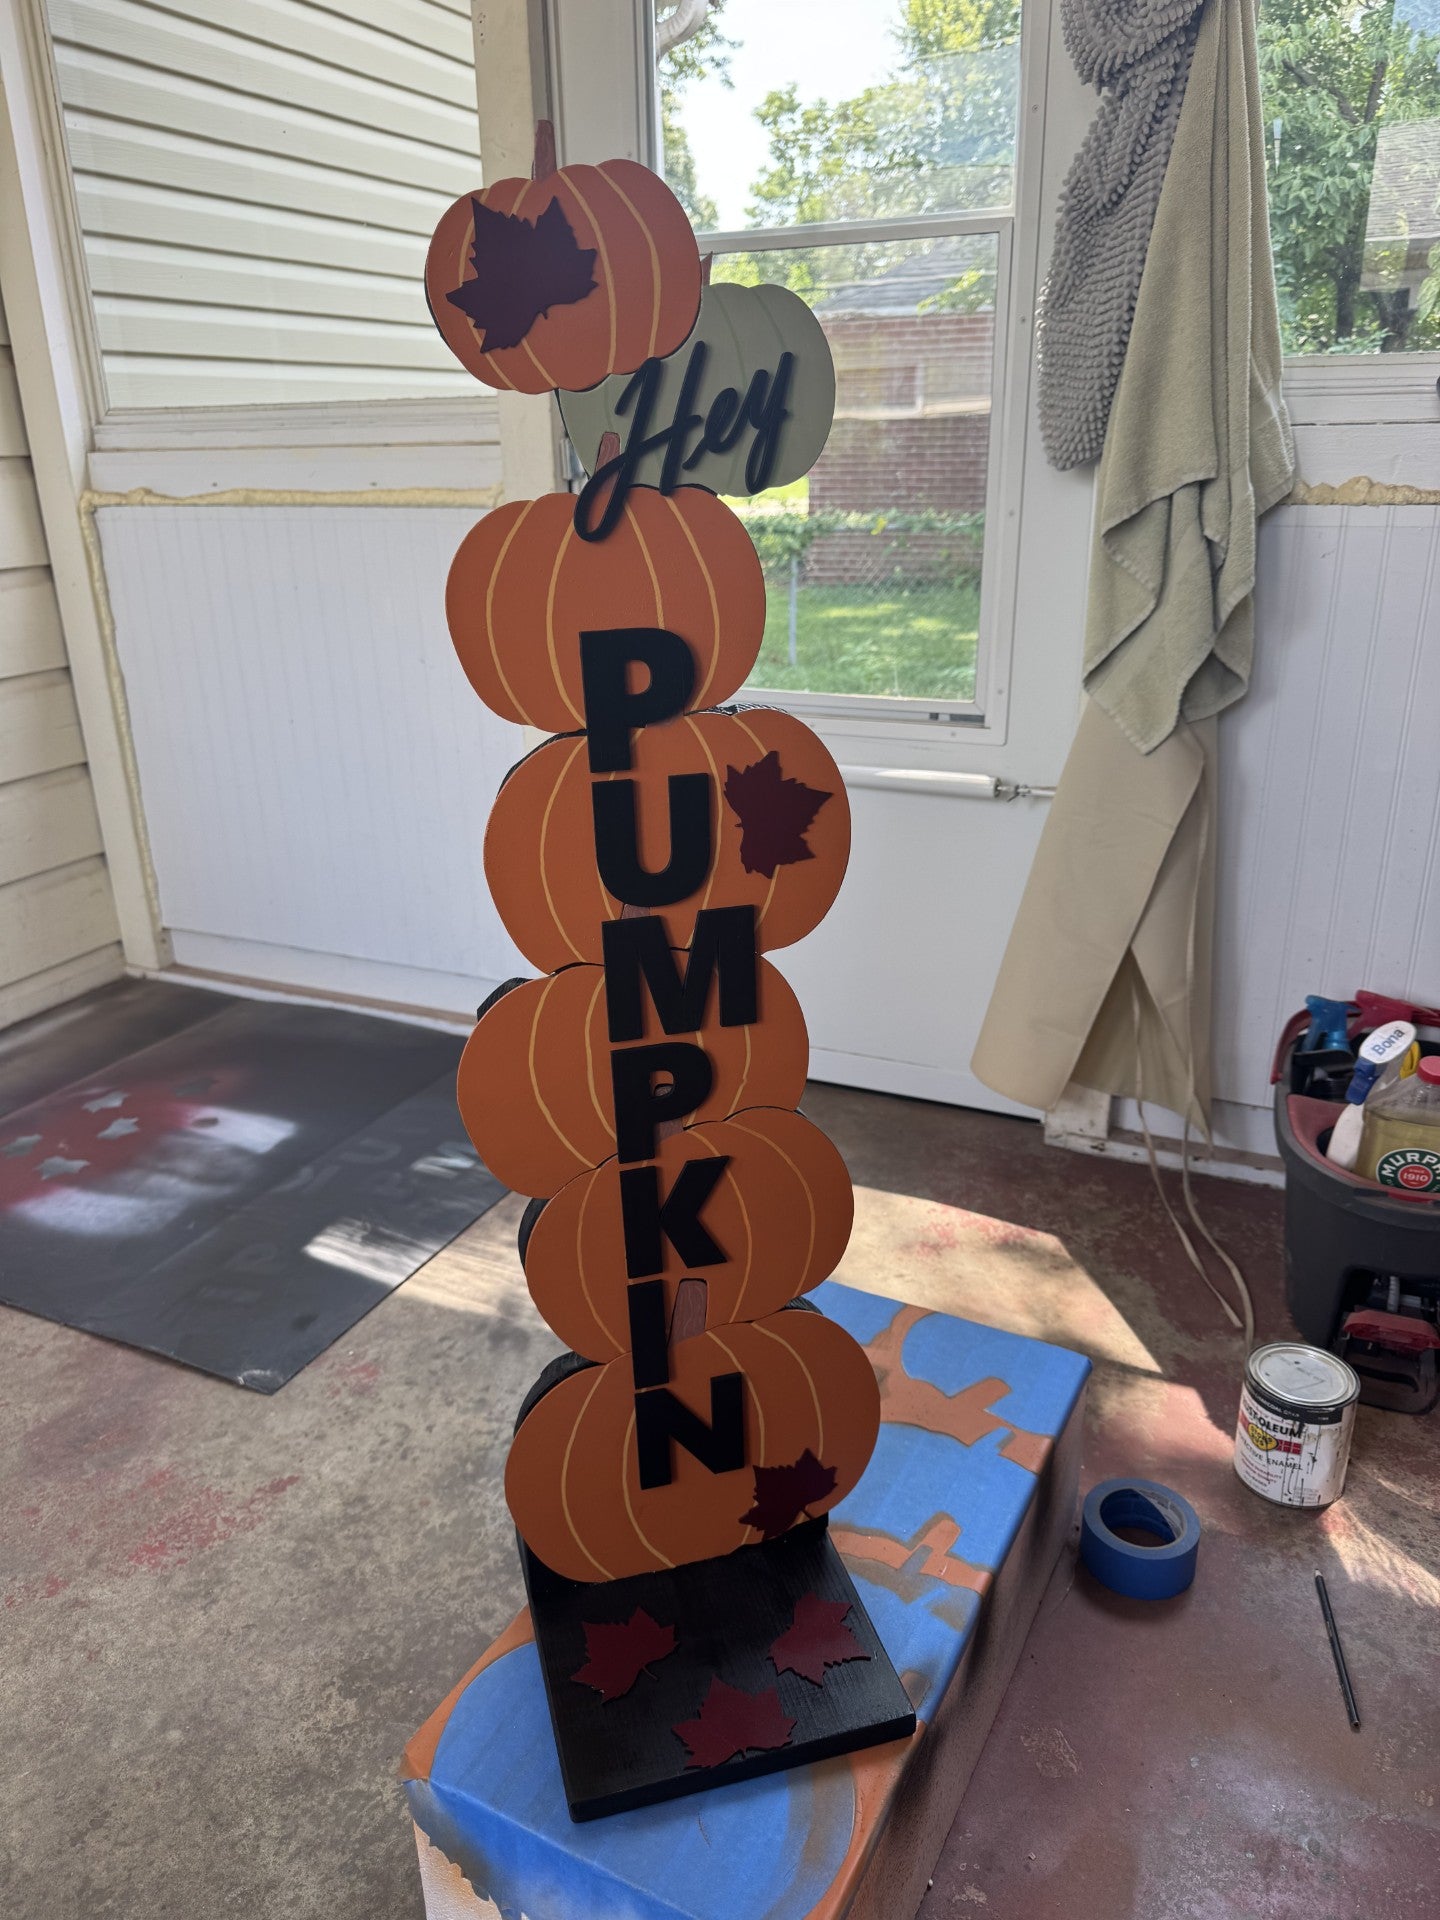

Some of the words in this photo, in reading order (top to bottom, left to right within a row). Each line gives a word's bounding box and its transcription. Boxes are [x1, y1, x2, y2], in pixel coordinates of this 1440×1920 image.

[574, 341, 794, 542] Hey
[1371, 1029, 1405, 1055] Bona
[579, 627, 757, 1490] PUMPKIN
[1403, 1172, 1429, 1182] 1910
[1266, 1456, 1303, 1471] ENAMEL
